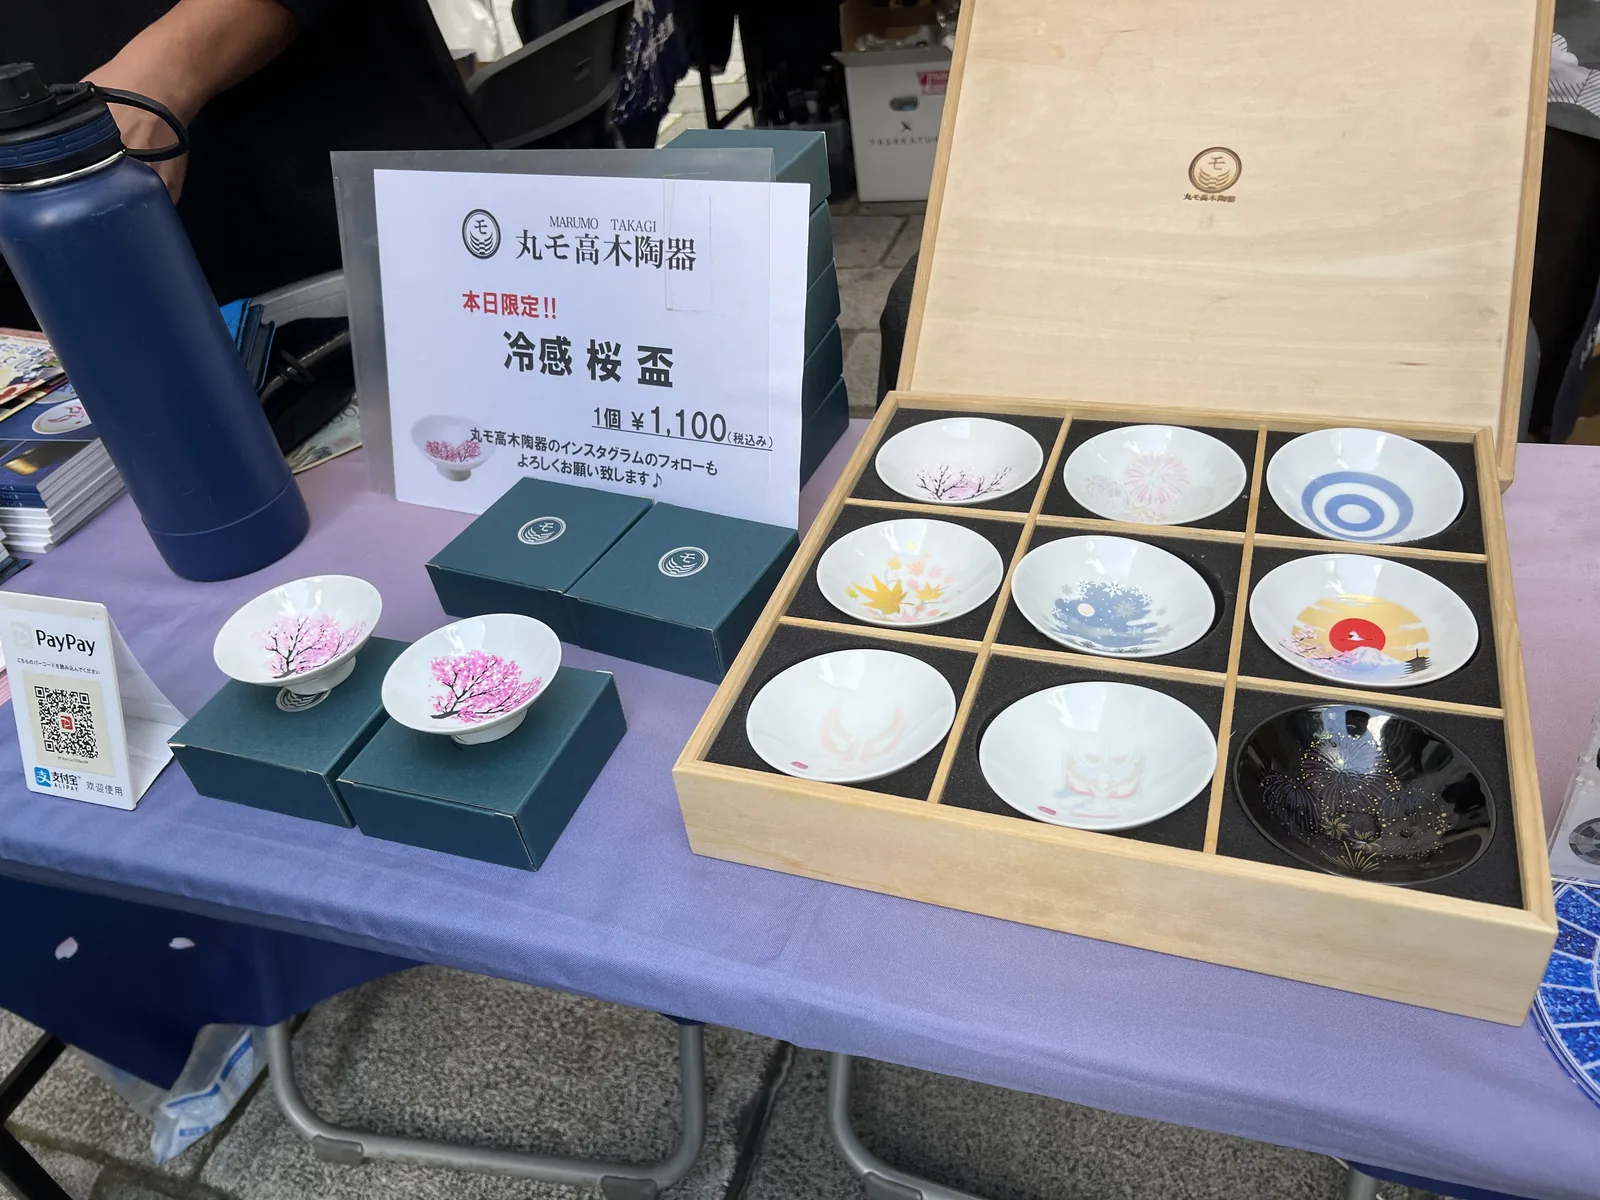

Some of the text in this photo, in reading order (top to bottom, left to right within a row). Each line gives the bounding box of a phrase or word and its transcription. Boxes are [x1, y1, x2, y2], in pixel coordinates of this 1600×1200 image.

[549, 215, 658, 233] MARUMO TAKAGI
[515, 230, 697, 272] 丸モ高木陶器
[462, 289, 558, 320] 本日限定!!
[503, 331, 675, 388] 冷感 桜 盃
[593, 407, 622, 431] 1個
[470, 427, 719, 477] 丸モ高木陶器のインスタグラムのフォローも
[35, 629, 96, 657] PayPay
[54, 783, 79, 792] ALIPAY
[86, 781, 123, 797] 欢迎使用
